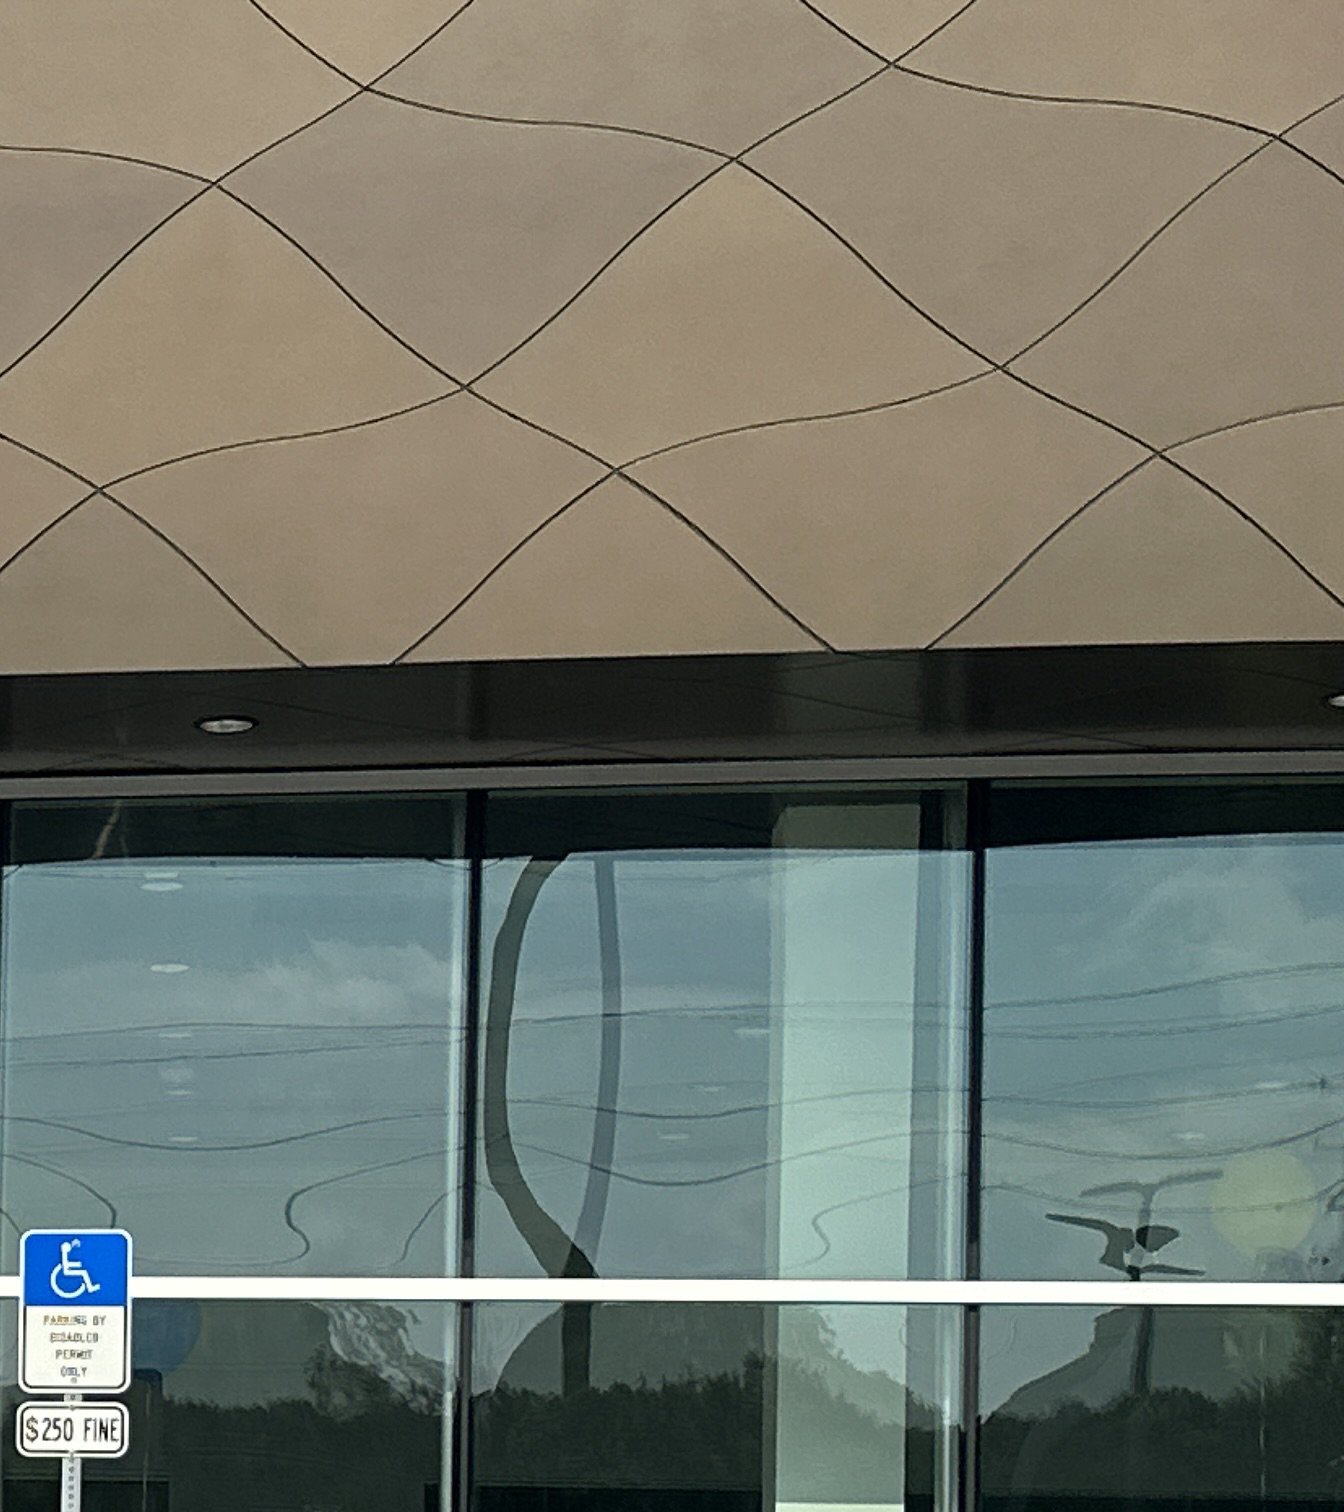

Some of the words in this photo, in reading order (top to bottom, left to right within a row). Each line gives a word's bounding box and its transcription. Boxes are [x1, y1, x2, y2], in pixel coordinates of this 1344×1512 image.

[43, 1315, 87, 1325] PARKING
[92, 1315, 107, 1326] BY
[55, 1349, 93, 1360] PERMIT
[25, 1416, 74, 1443] $250
[83, 1417, 120, 1442] FINE
